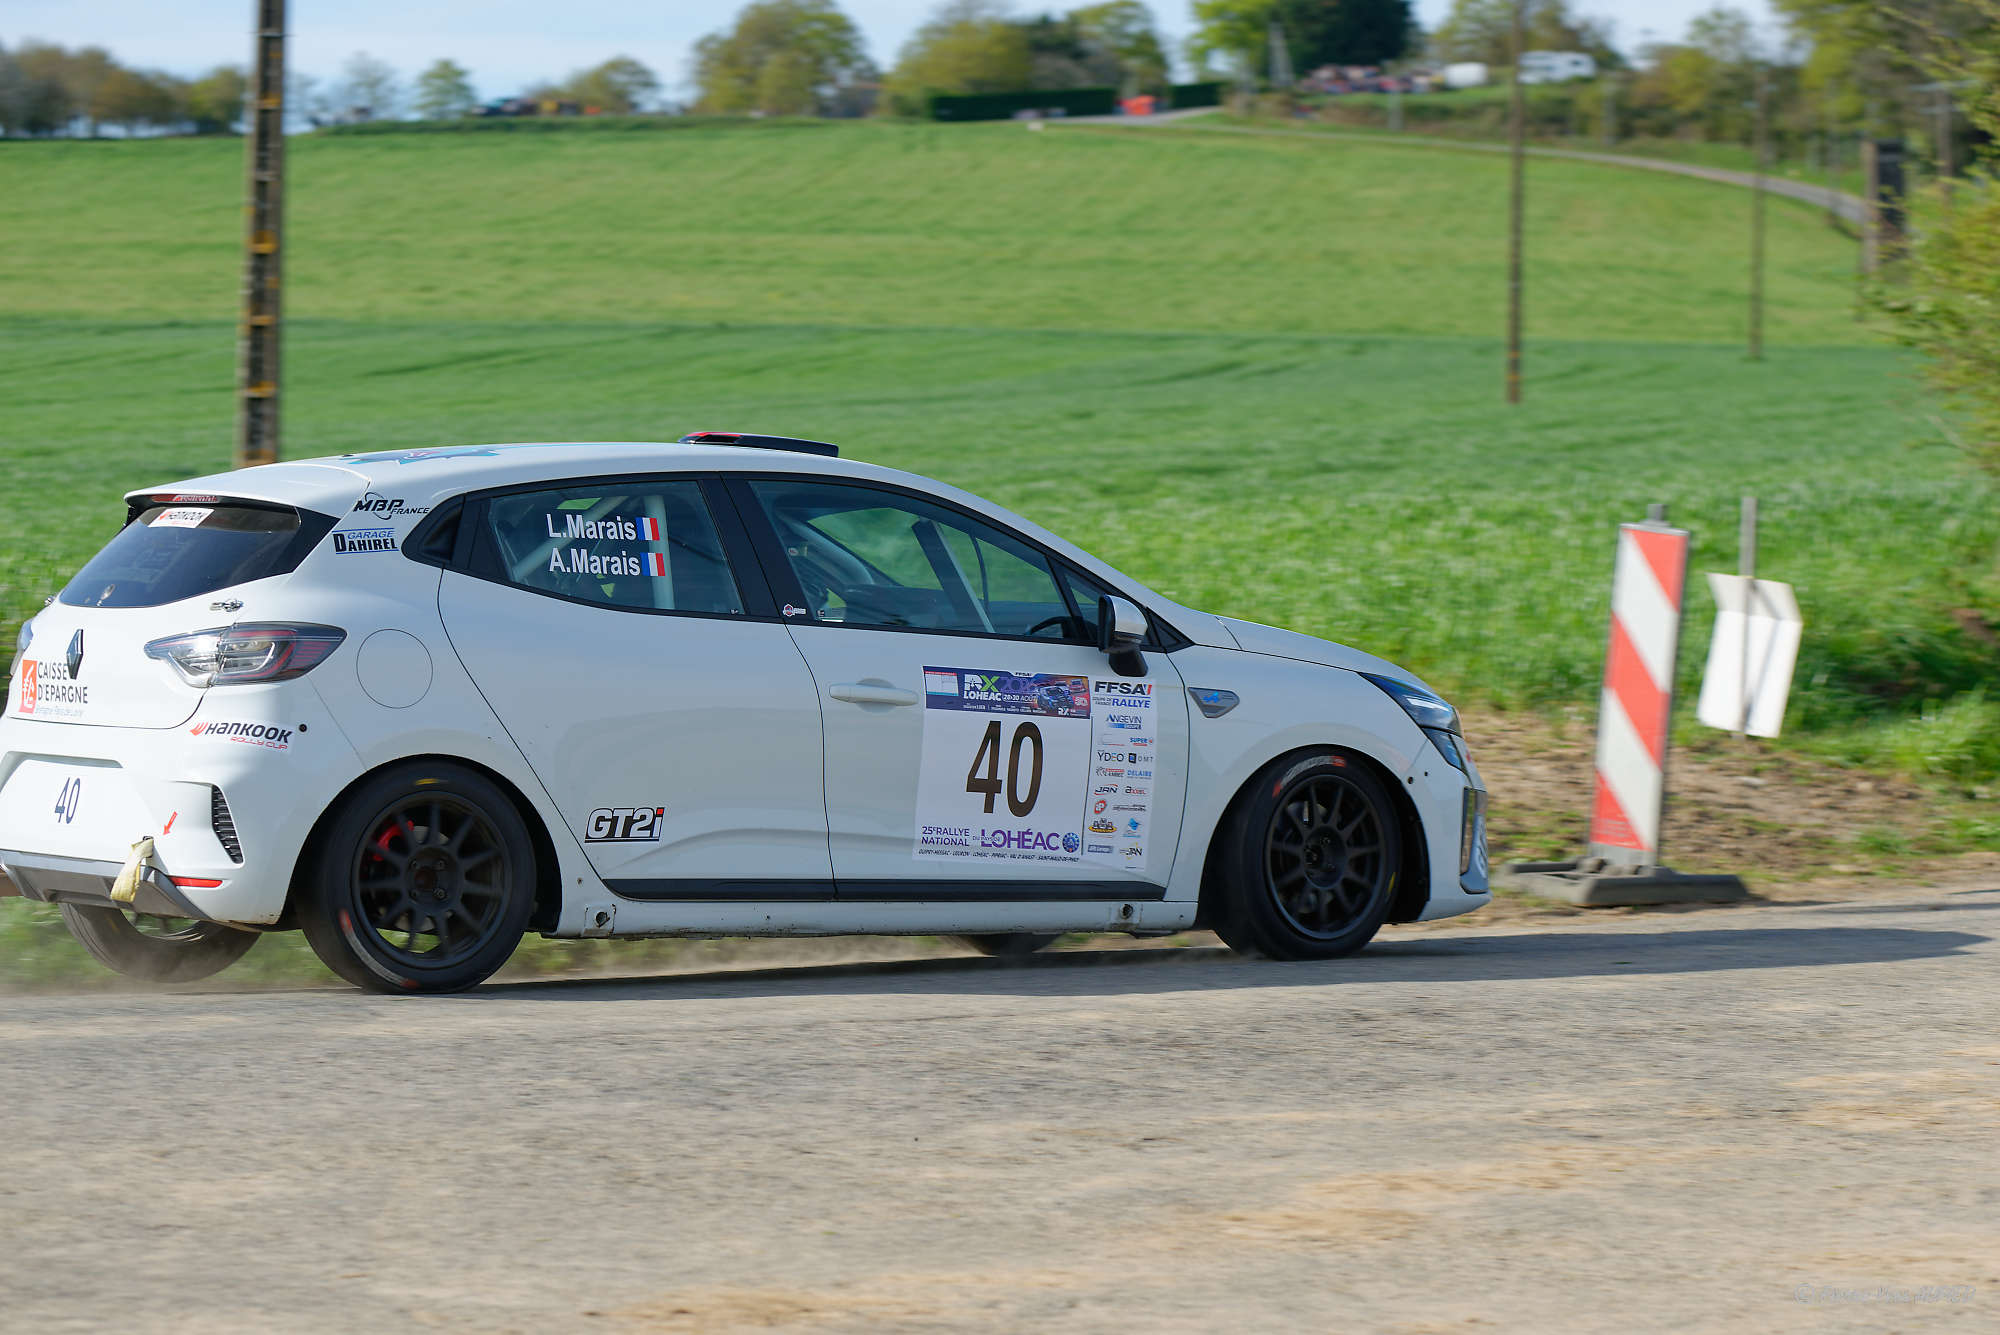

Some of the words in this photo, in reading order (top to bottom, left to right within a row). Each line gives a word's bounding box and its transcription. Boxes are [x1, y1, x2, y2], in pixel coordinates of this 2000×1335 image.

[353, 499, 404, 512] MBP
[390, 507, 430, 515] FRANCE
[347, 530, 395, 540] GARAGE
[546, 513, 637, 541] L.Marais
[332, 533, 398, 552] DAHIREL
[549, 547, 641, 576] A.Marais
[37, 661, 68, 680] CAISSE
[963, 691, 1002, 702] LOHEAC
[1094, 681, 1147, 695] FFSA
[1112, 698, 1151, 708] RALLYE
[1105, 714, 1142, 723] ANGEVIN
[966, 720, 1043, 817] 40
[55, 776, 81, 824] 40
[585, 807, 665, 839] GT2i
[921, 837, 970, 847] NATIONAL
[980, 828, 1060, 850] LOHÉAC
